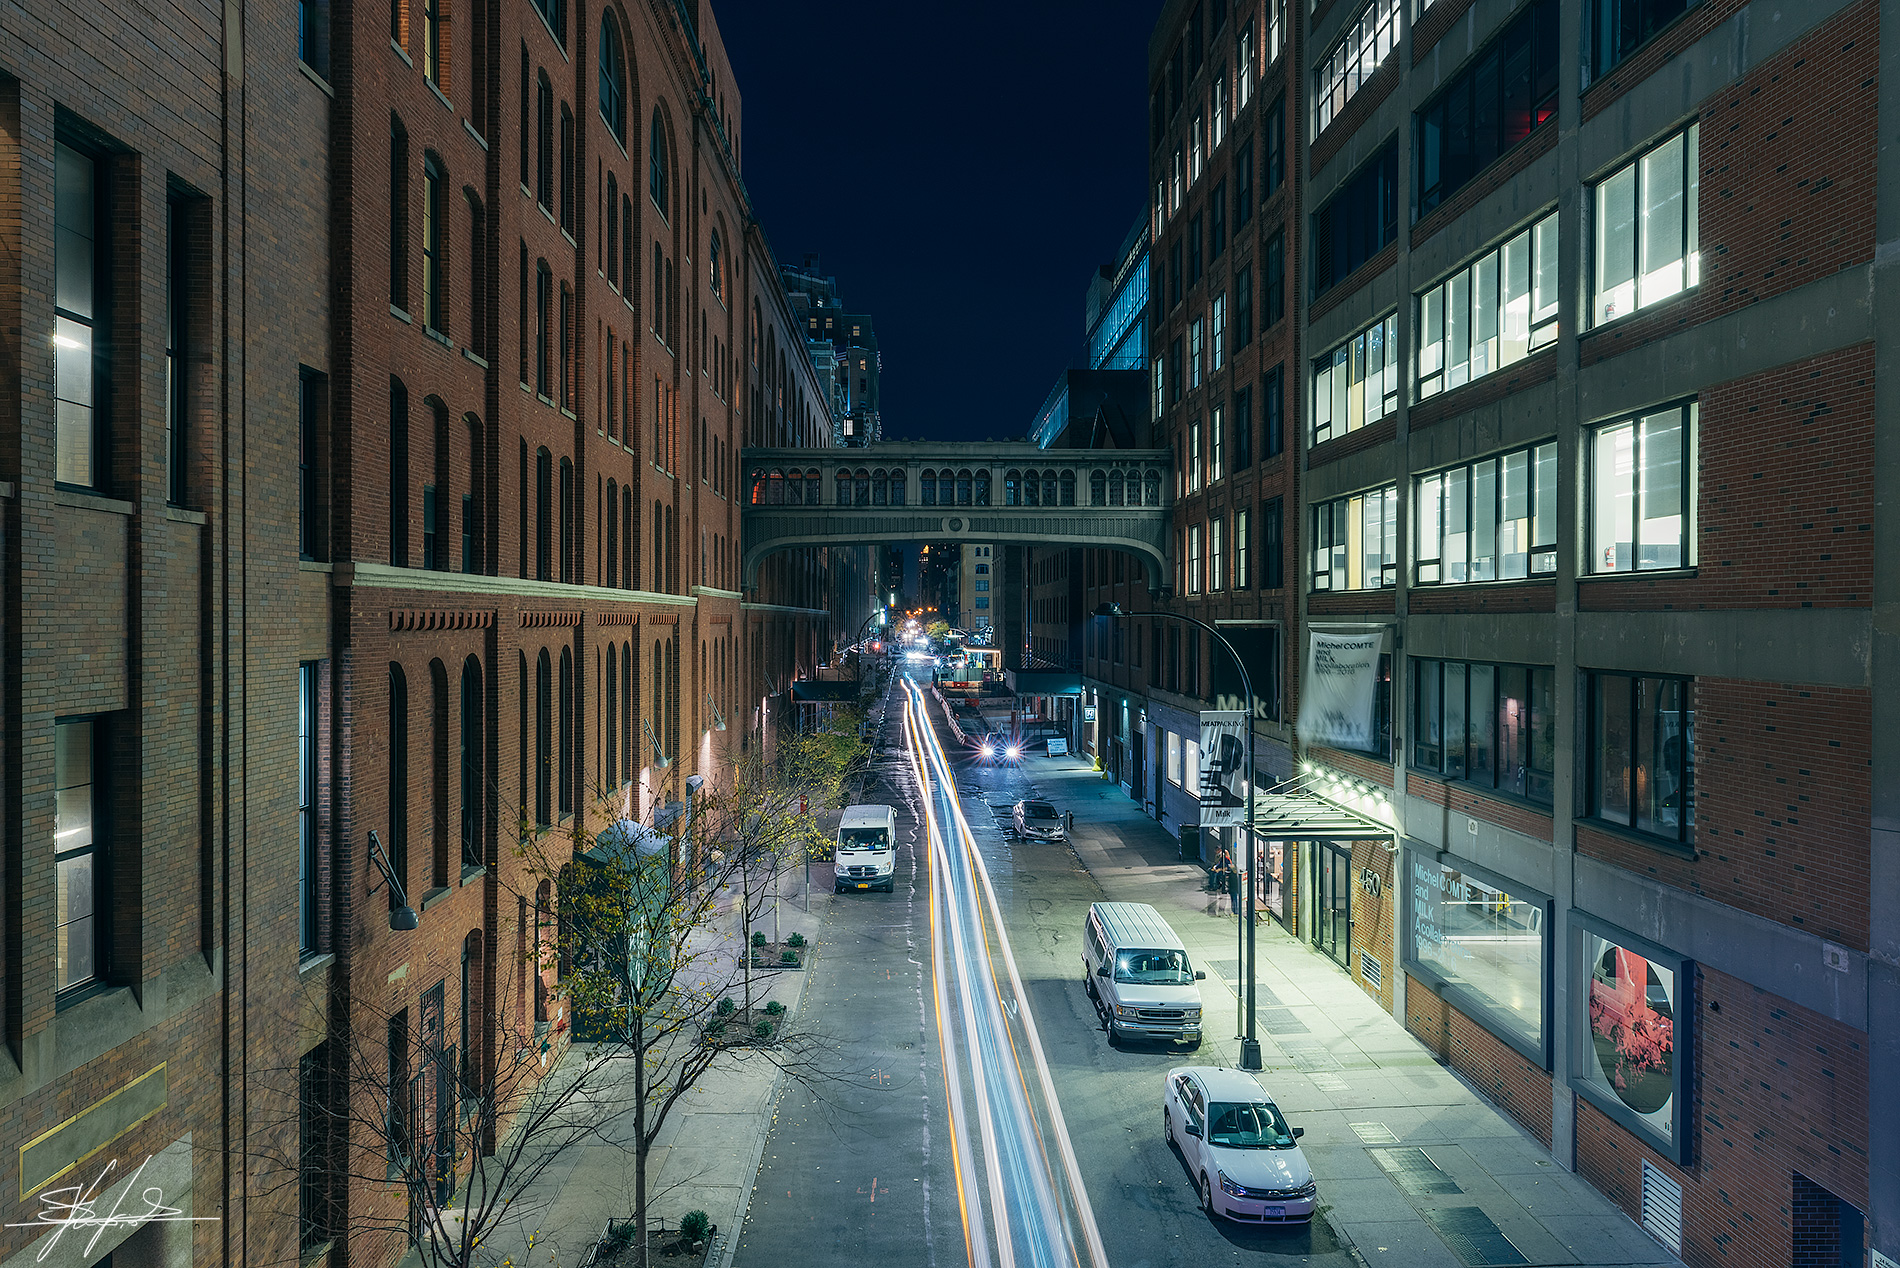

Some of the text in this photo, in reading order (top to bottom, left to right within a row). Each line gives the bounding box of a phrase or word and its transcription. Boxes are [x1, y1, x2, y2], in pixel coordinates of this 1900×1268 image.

[1316, 640, 1374, 650] Michel COMTE
[1315, 655, 1335, 663] MILK
[1215, 810, 1231, 818] Milk
[1359, 866, 1381, 897] 450
[1414, 862, 1471, 905] Michel COMTE
[1414, 884, 1429, 901] and
[1414, 897, 1434, 923] MILK
[1414, 916, 1421, 932] A
